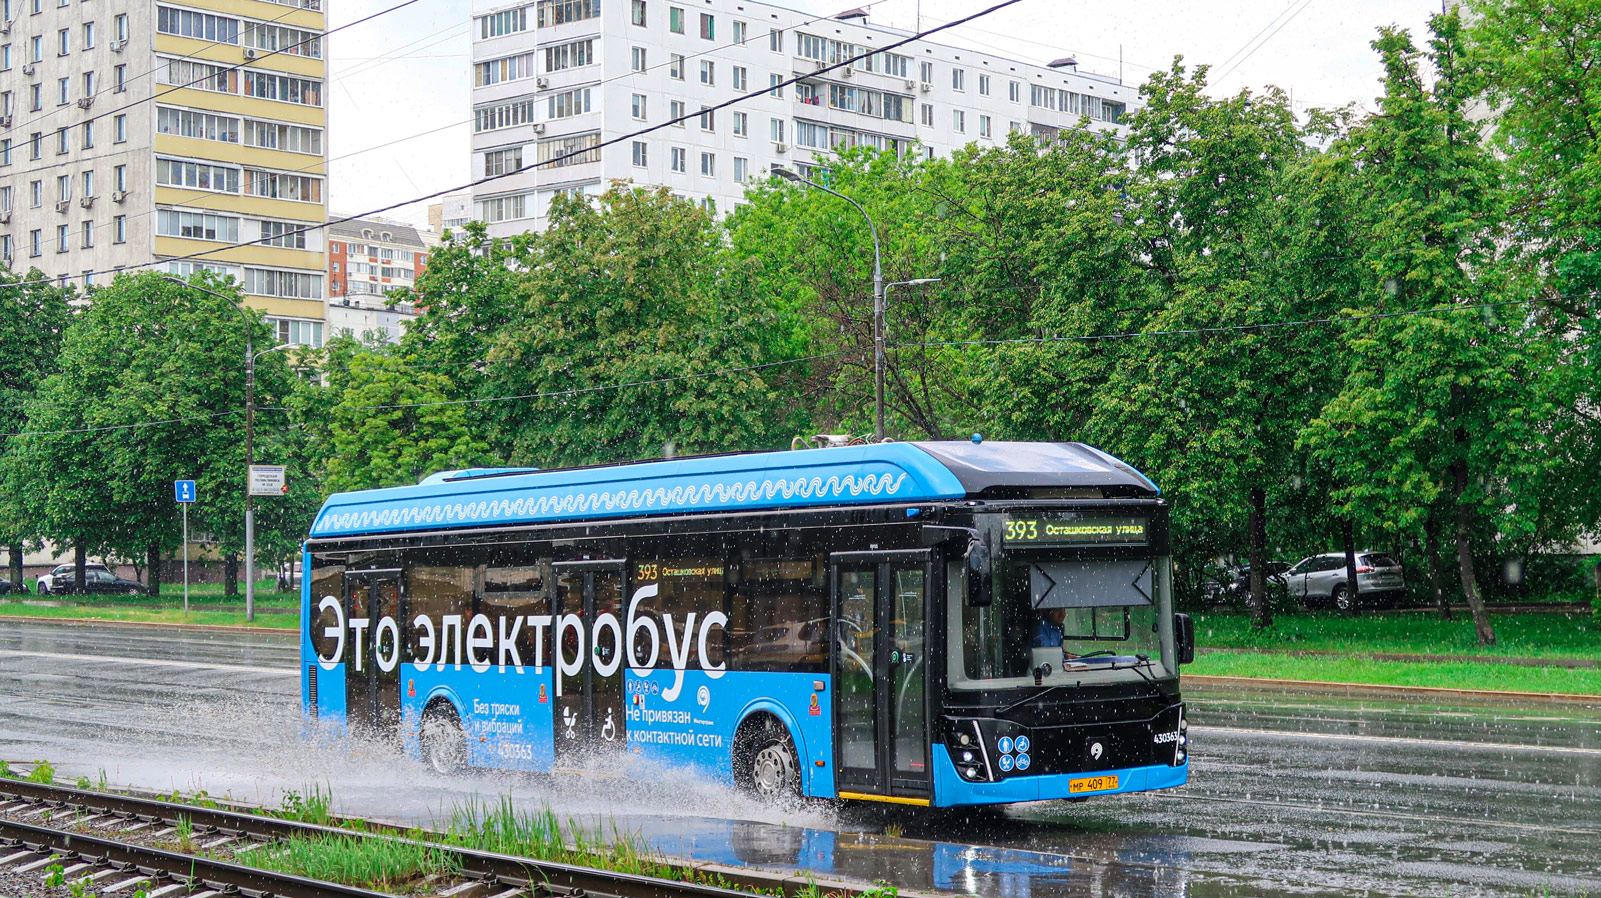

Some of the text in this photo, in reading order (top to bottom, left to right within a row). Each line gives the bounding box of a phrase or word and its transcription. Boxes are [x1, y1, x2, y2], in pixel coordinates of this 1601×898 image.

[1005, 521, 1144, 540] 393 Осташковская улица
[637, 564, 658, 580] 393
[662, 566, 705, 576] Осташковская
[317, 583, 728, 702] Это электробус
[473, 698, 520, 718] Без тряски
[625, 704, 640, 722] Не
[642, 709, 691, 726] привязан
[474, 718, 523, 736] и вибраций
[626, 729, 722, 748] к контактной сети
[1153, 731, 1178, 744] 430363
[498, 743, 532, 760] 430363
[1087, 778, 1103, 790] 409
[1107, 776, 1116, 785] 77
